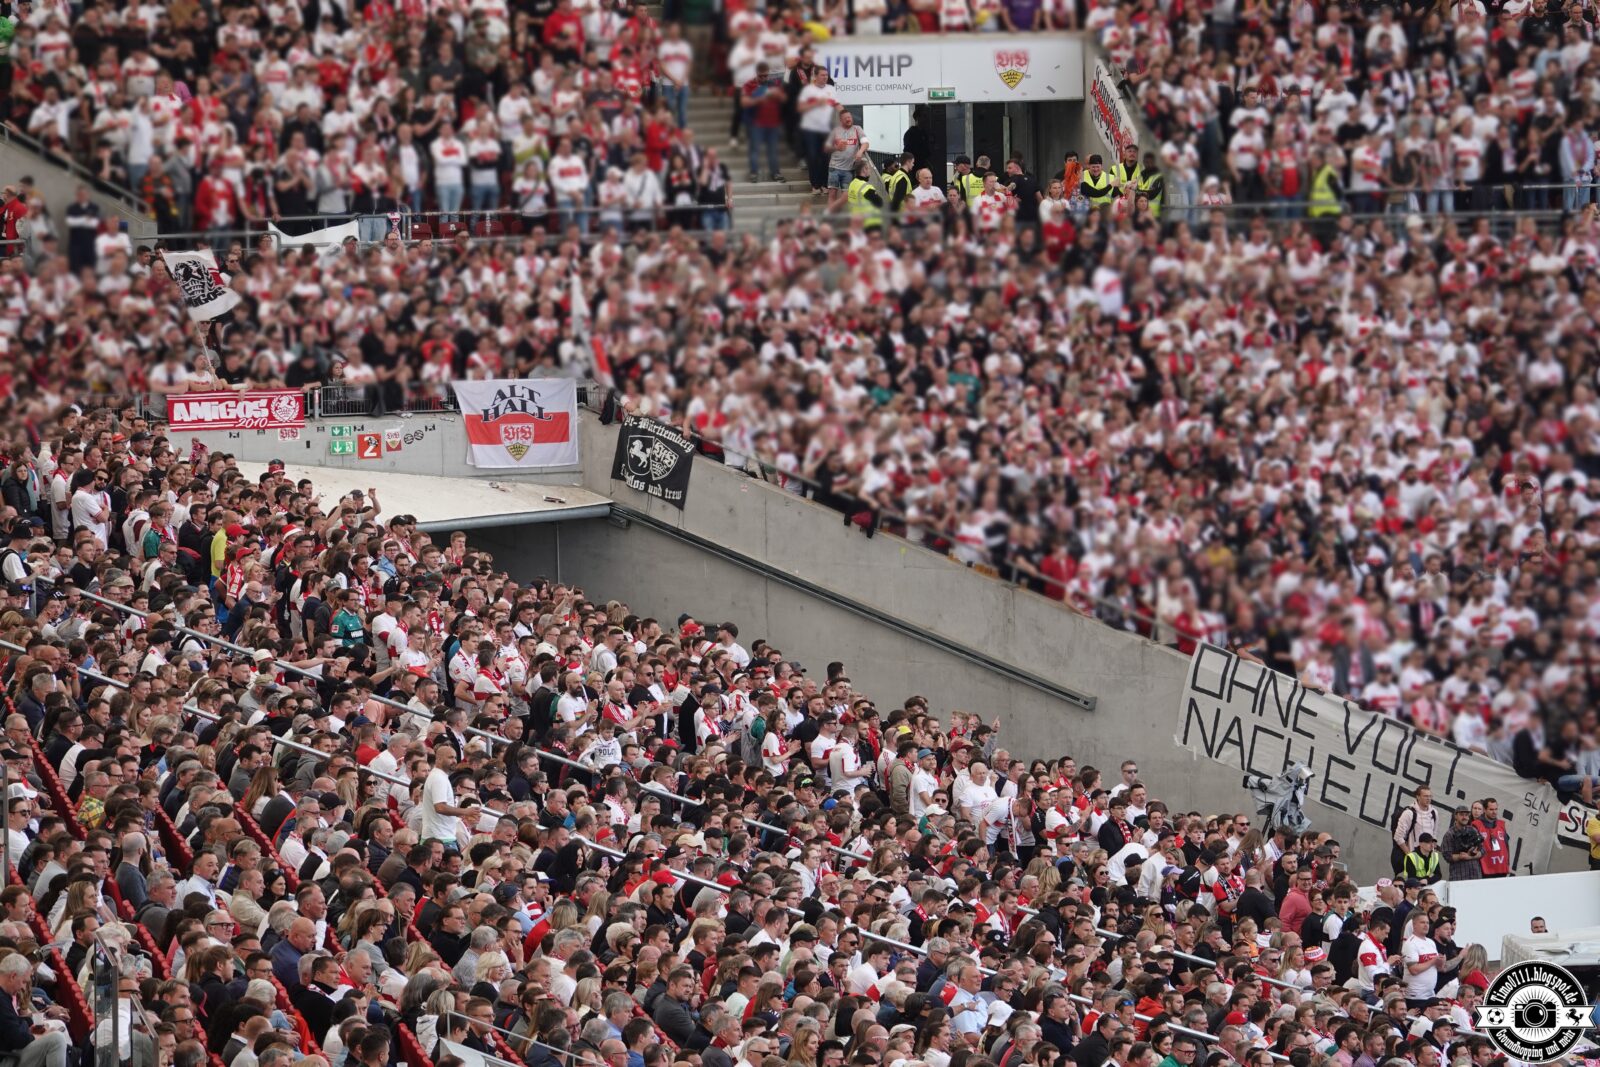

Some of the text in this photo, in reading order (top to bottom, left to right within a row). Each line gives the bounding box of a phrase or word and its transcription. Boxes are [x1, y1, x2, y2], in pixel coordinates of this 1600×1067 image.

[854, 54, 913, 78] MHP
[835, 83, 872, 92] PORSCHE
[875, 83, 913, 91] COMPANY
[491, 384, 541, 407] ALT
[481, 399, 553, 423] HALL
[238, 418, 268, 429] 2010
[363, 436, 378, 457] 2
[647, 483, 663, 497] und
[1191, 643, 1323, 740] OHNE
[1183, 697, 1315, 796] NACH
[1522, 792, 1550, 814] SLN
[1490, 855, 1505, 865] TV
